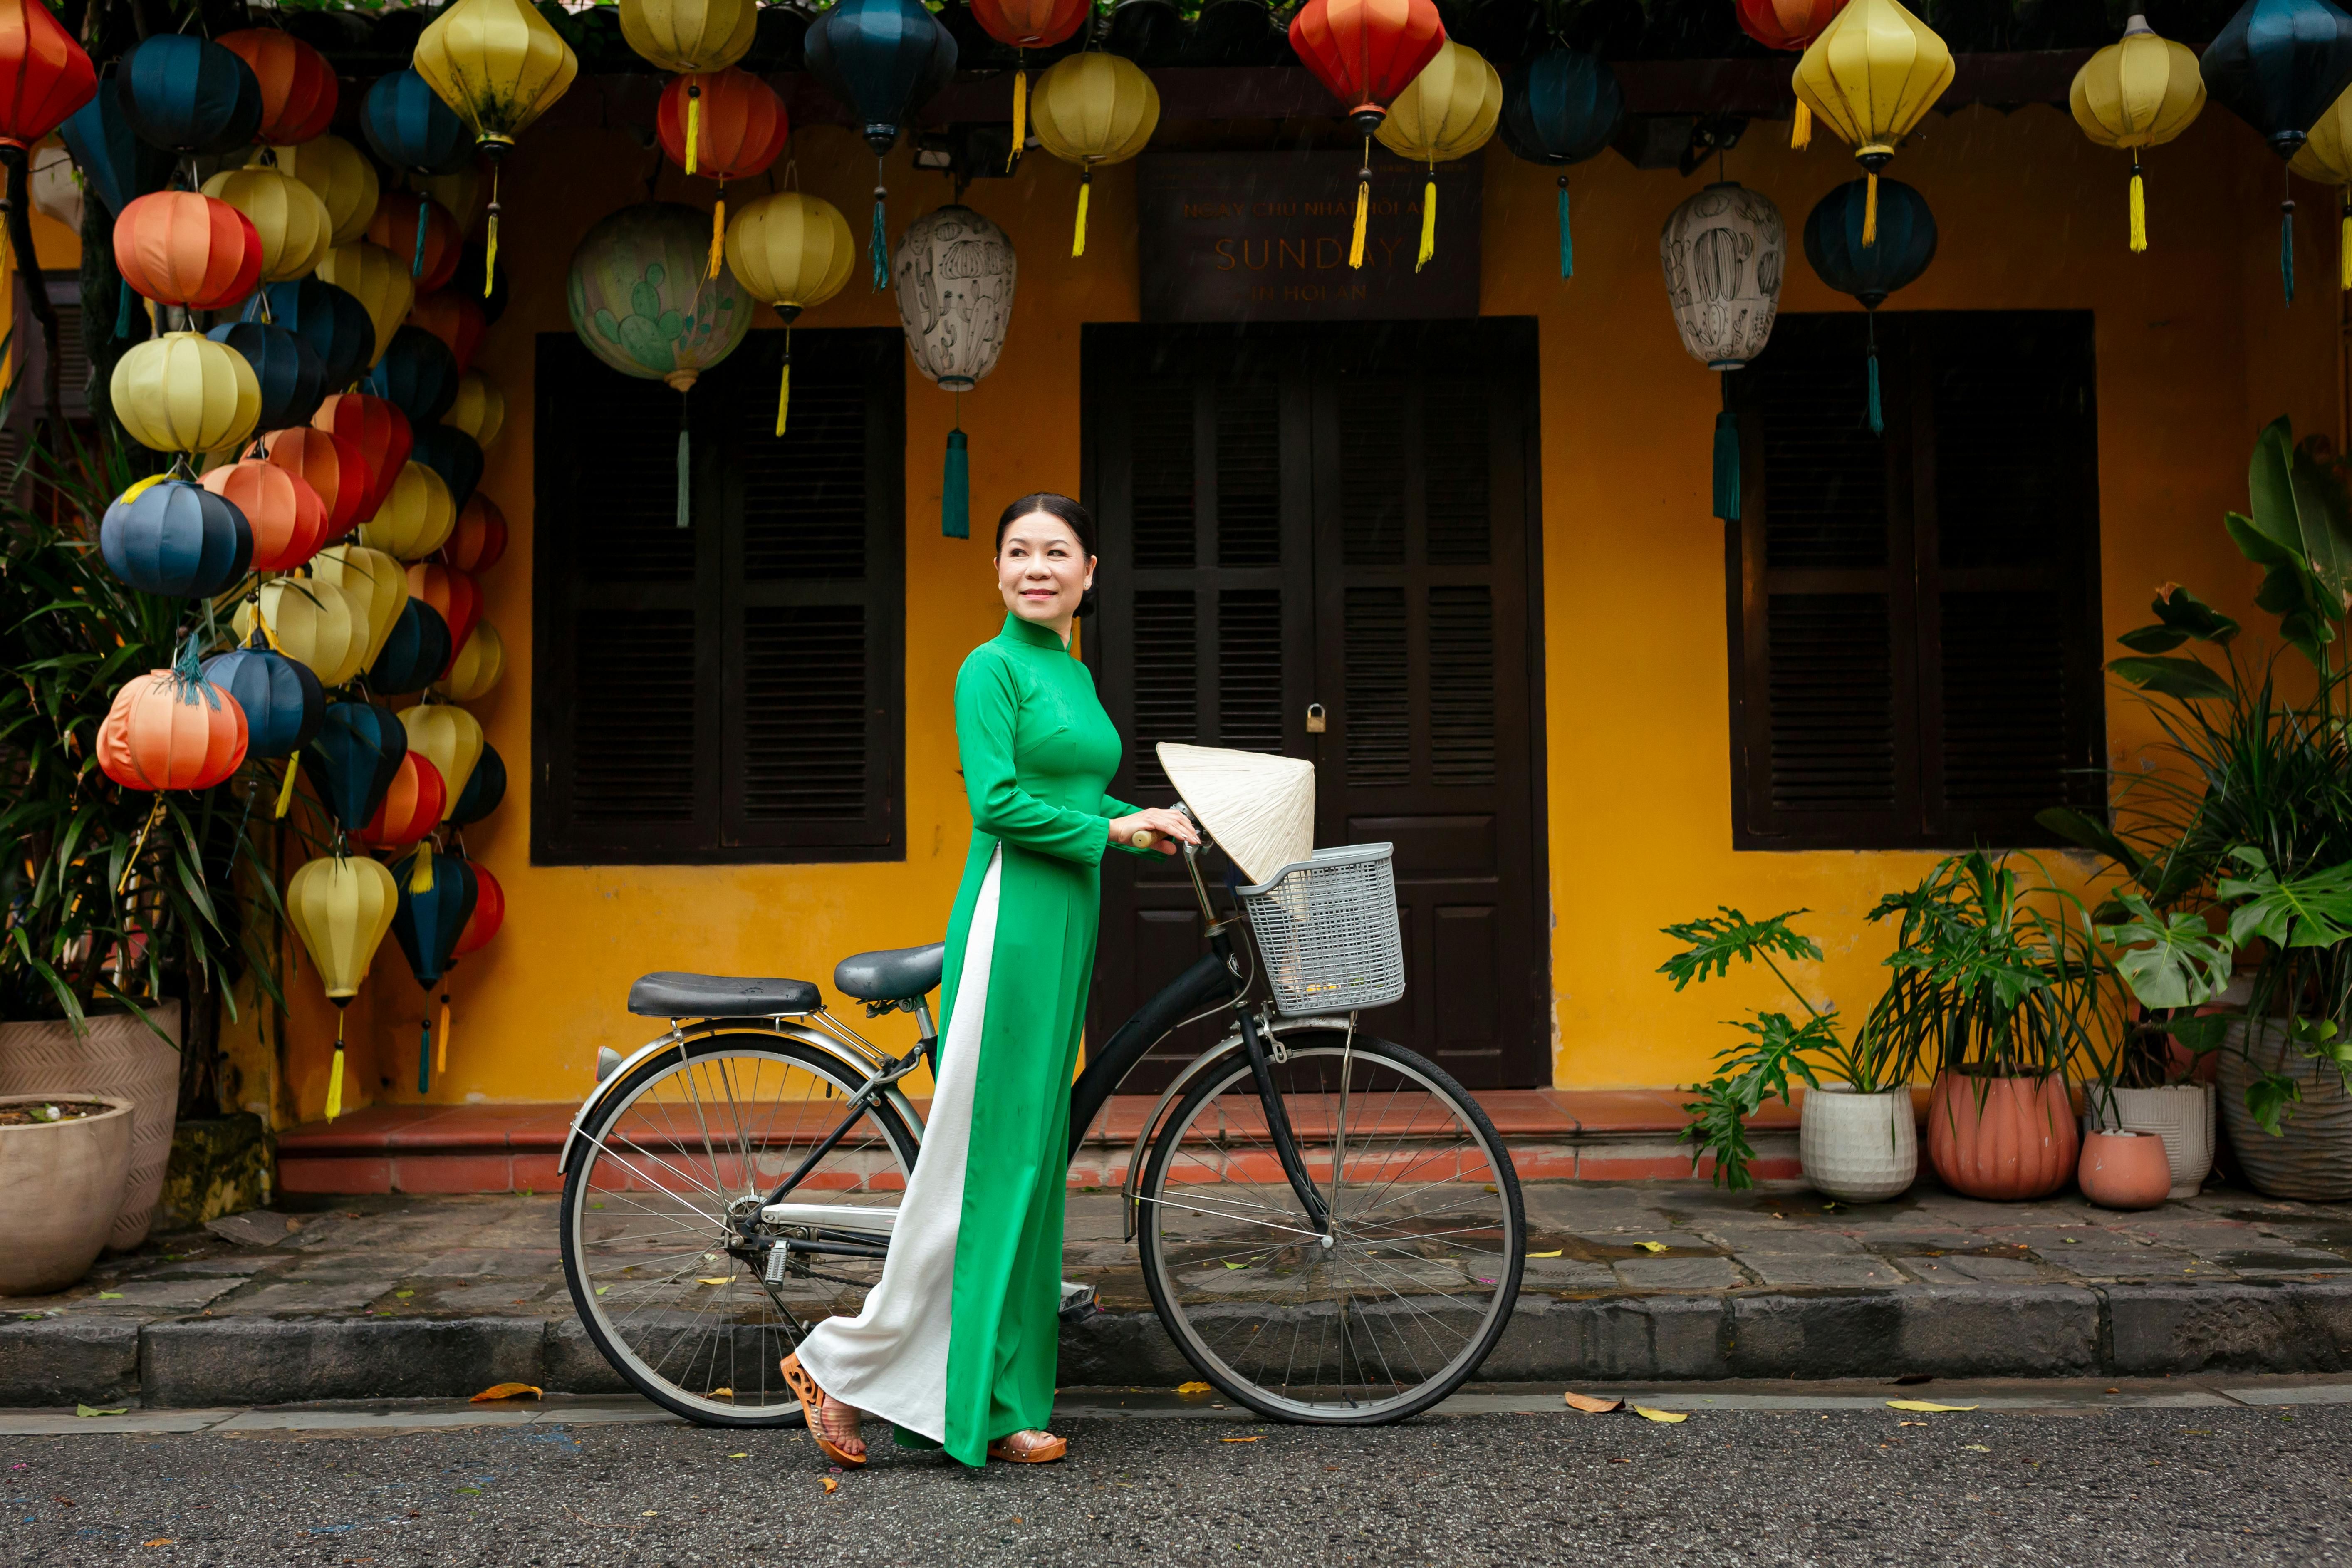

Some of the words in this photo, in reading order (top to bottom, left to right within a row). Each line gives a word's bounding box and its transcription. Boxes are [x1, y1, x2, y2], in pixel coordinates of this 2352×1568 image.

[1406, 201, 1425, 216] A
[1251, 285, 1274, 300] IN
[1336, 285, 1367, 300] AN
